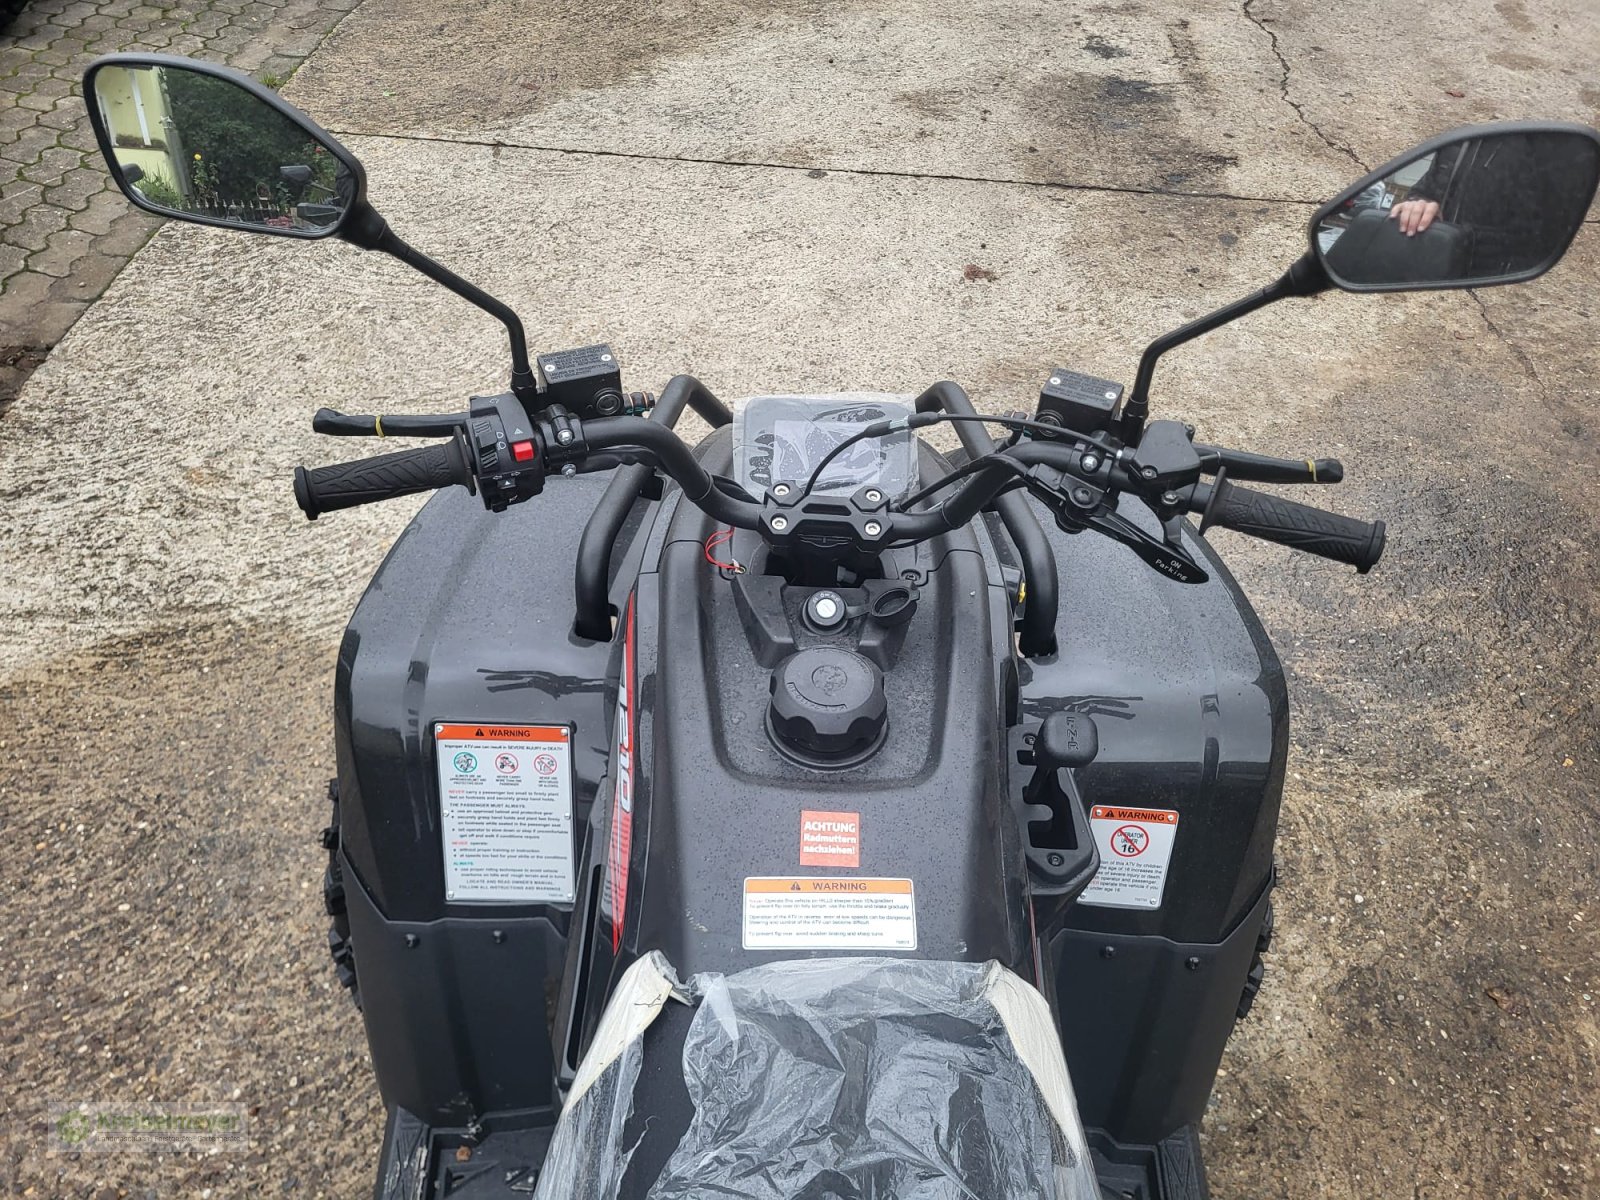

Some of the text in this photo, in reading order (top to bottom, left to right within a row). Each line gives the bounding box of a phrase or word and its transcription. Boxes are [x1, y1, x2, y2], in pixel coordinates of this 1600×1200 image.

[1170, 560, 1181, 569] ON
[1155, 558, 1188, 582] Parking
[488, 729, 530, 737] WARNING
[1117, 810, 1164, 820] WARNING
[804, 821, 856, 832] ACHTUNG
[803, 833, 857, 844] Radmuttern
[1120, 844, 1135, 852] 16
[812, 882, 866, 890] WARNING
